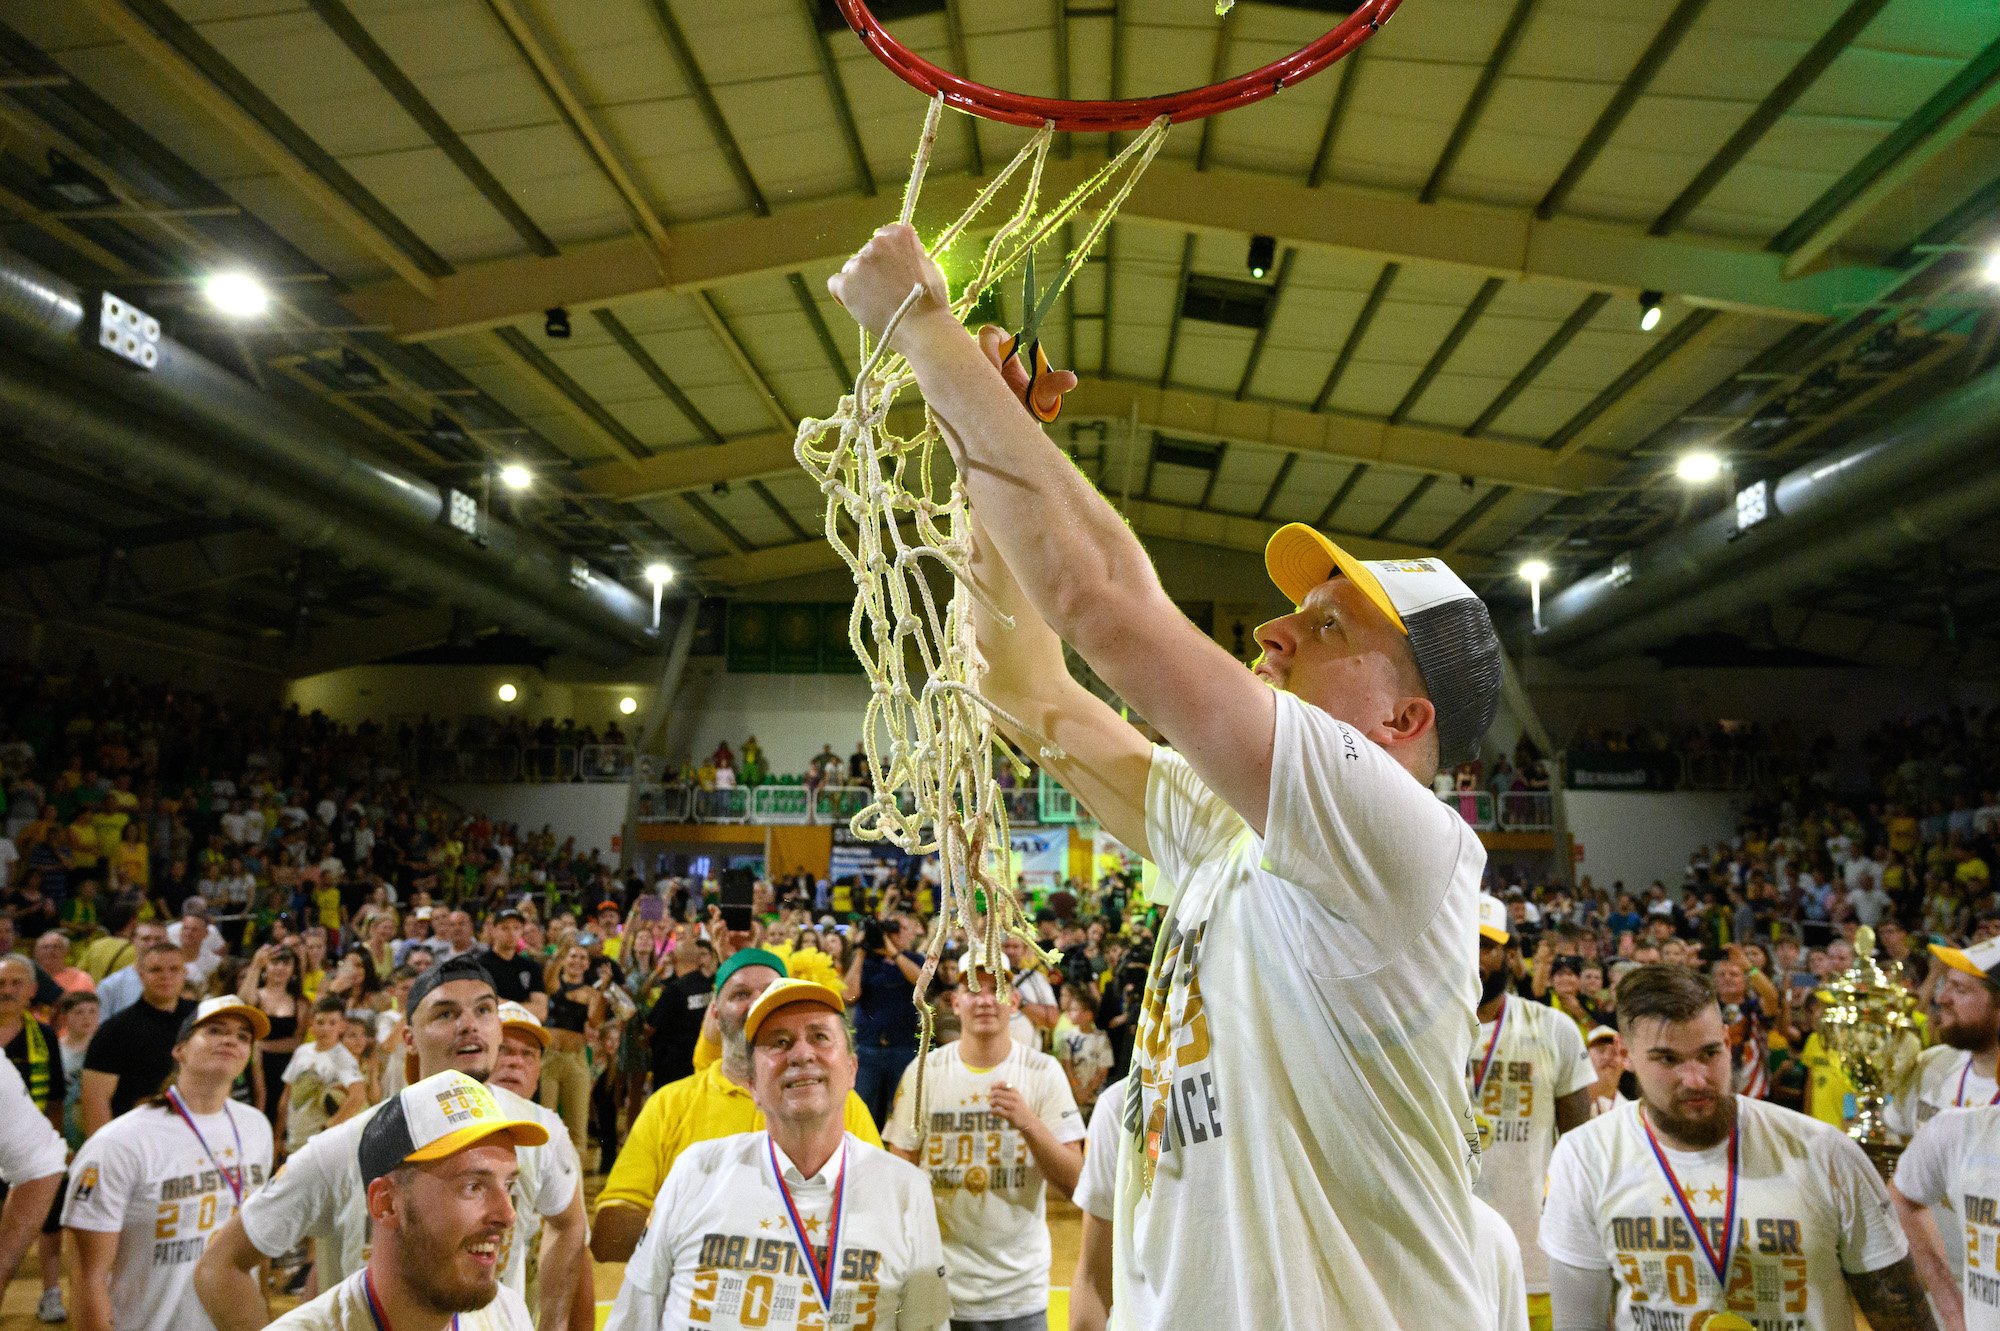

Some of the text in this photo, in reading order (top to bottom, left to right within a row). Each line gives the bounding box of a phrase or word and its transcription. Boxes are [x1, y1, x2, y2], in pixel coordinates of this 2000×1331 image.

[1490, 1120, 1529, 1142] EVICE
[1757, 1218, 1804, 1257] SR
[839, 1248, 882, 1283] SR
[721, 1277, 743, 1291] 2011
[773, 1298, 796, 1311] 2018
